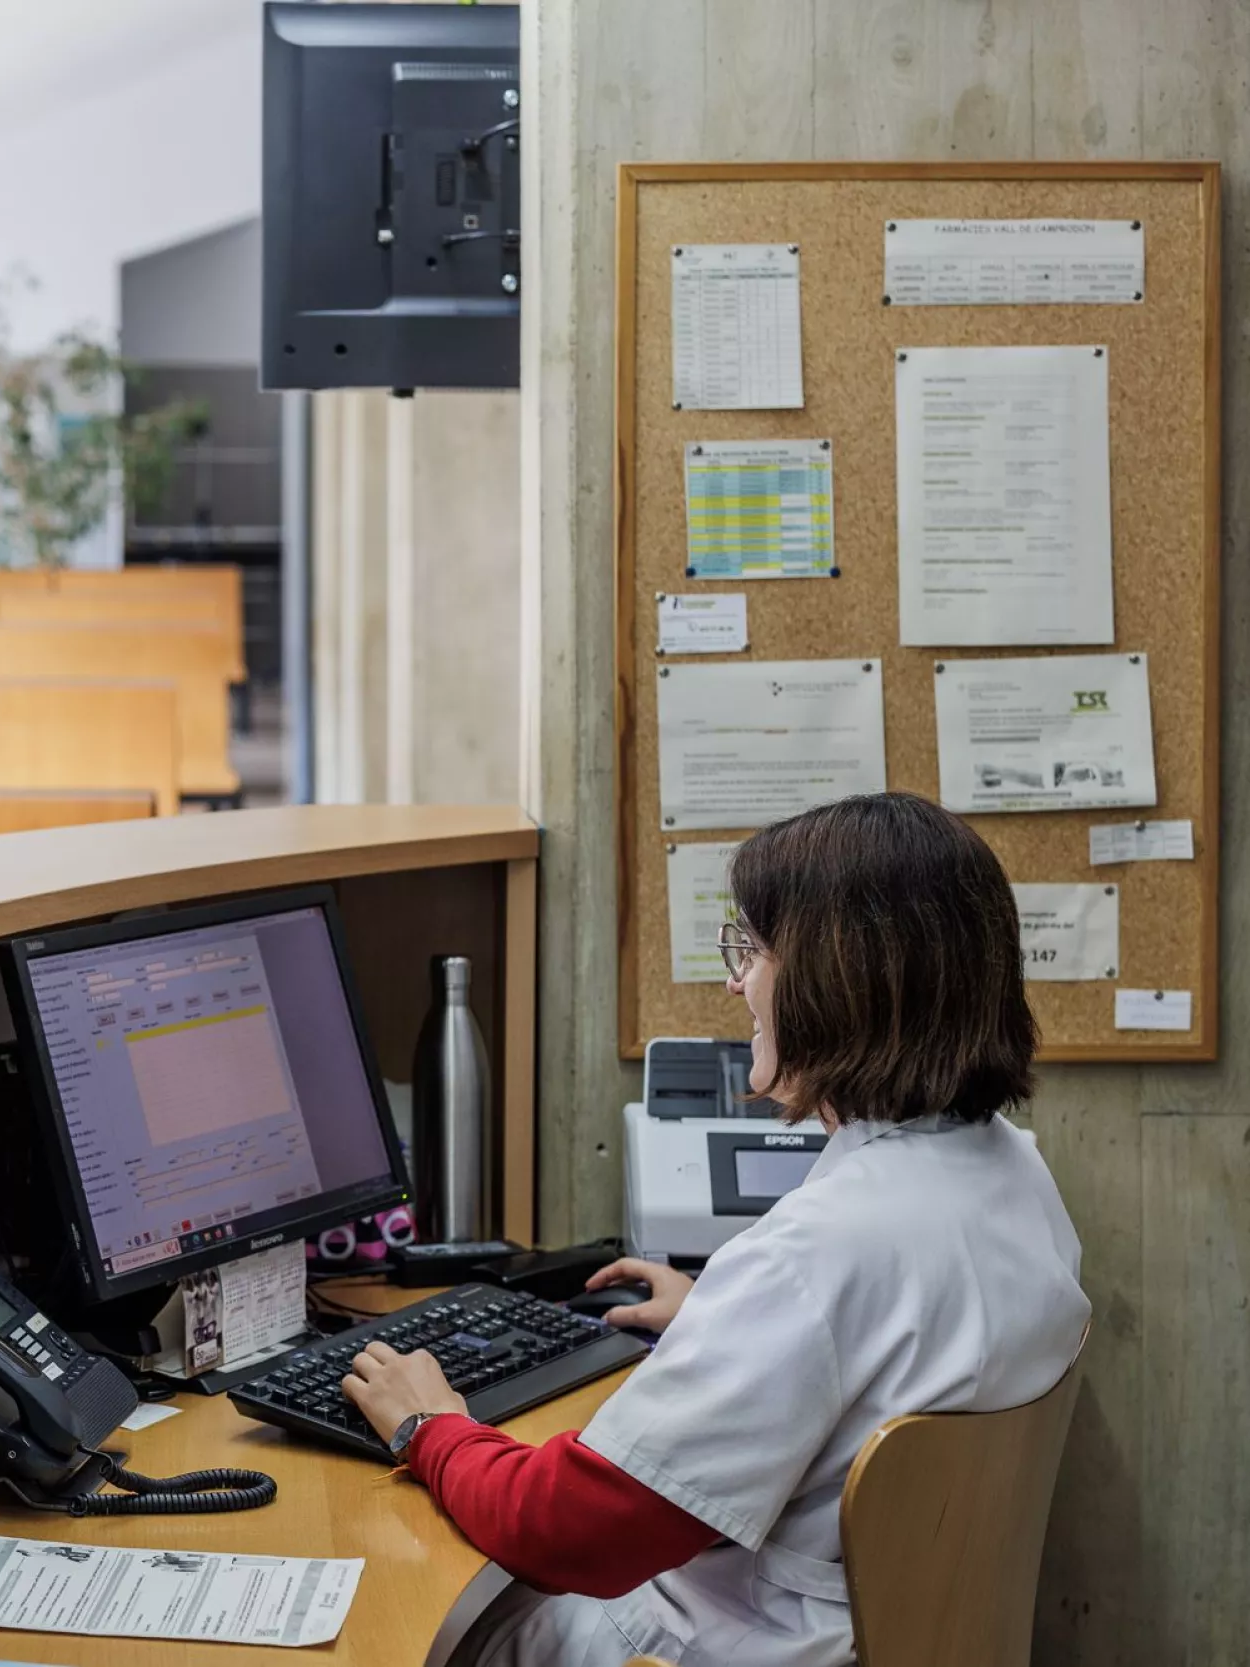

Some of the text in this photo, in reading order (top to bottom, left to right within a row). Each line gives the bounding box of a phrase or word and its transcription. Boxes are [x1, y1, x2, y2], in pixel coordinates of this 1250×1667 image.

[1019, 224, 1032, 234] DE
[1031, 948, 1057, 963] 147
[764, 1134, 805, 1146] EPSON
[250, 1232, 284, 1251] lenovo
